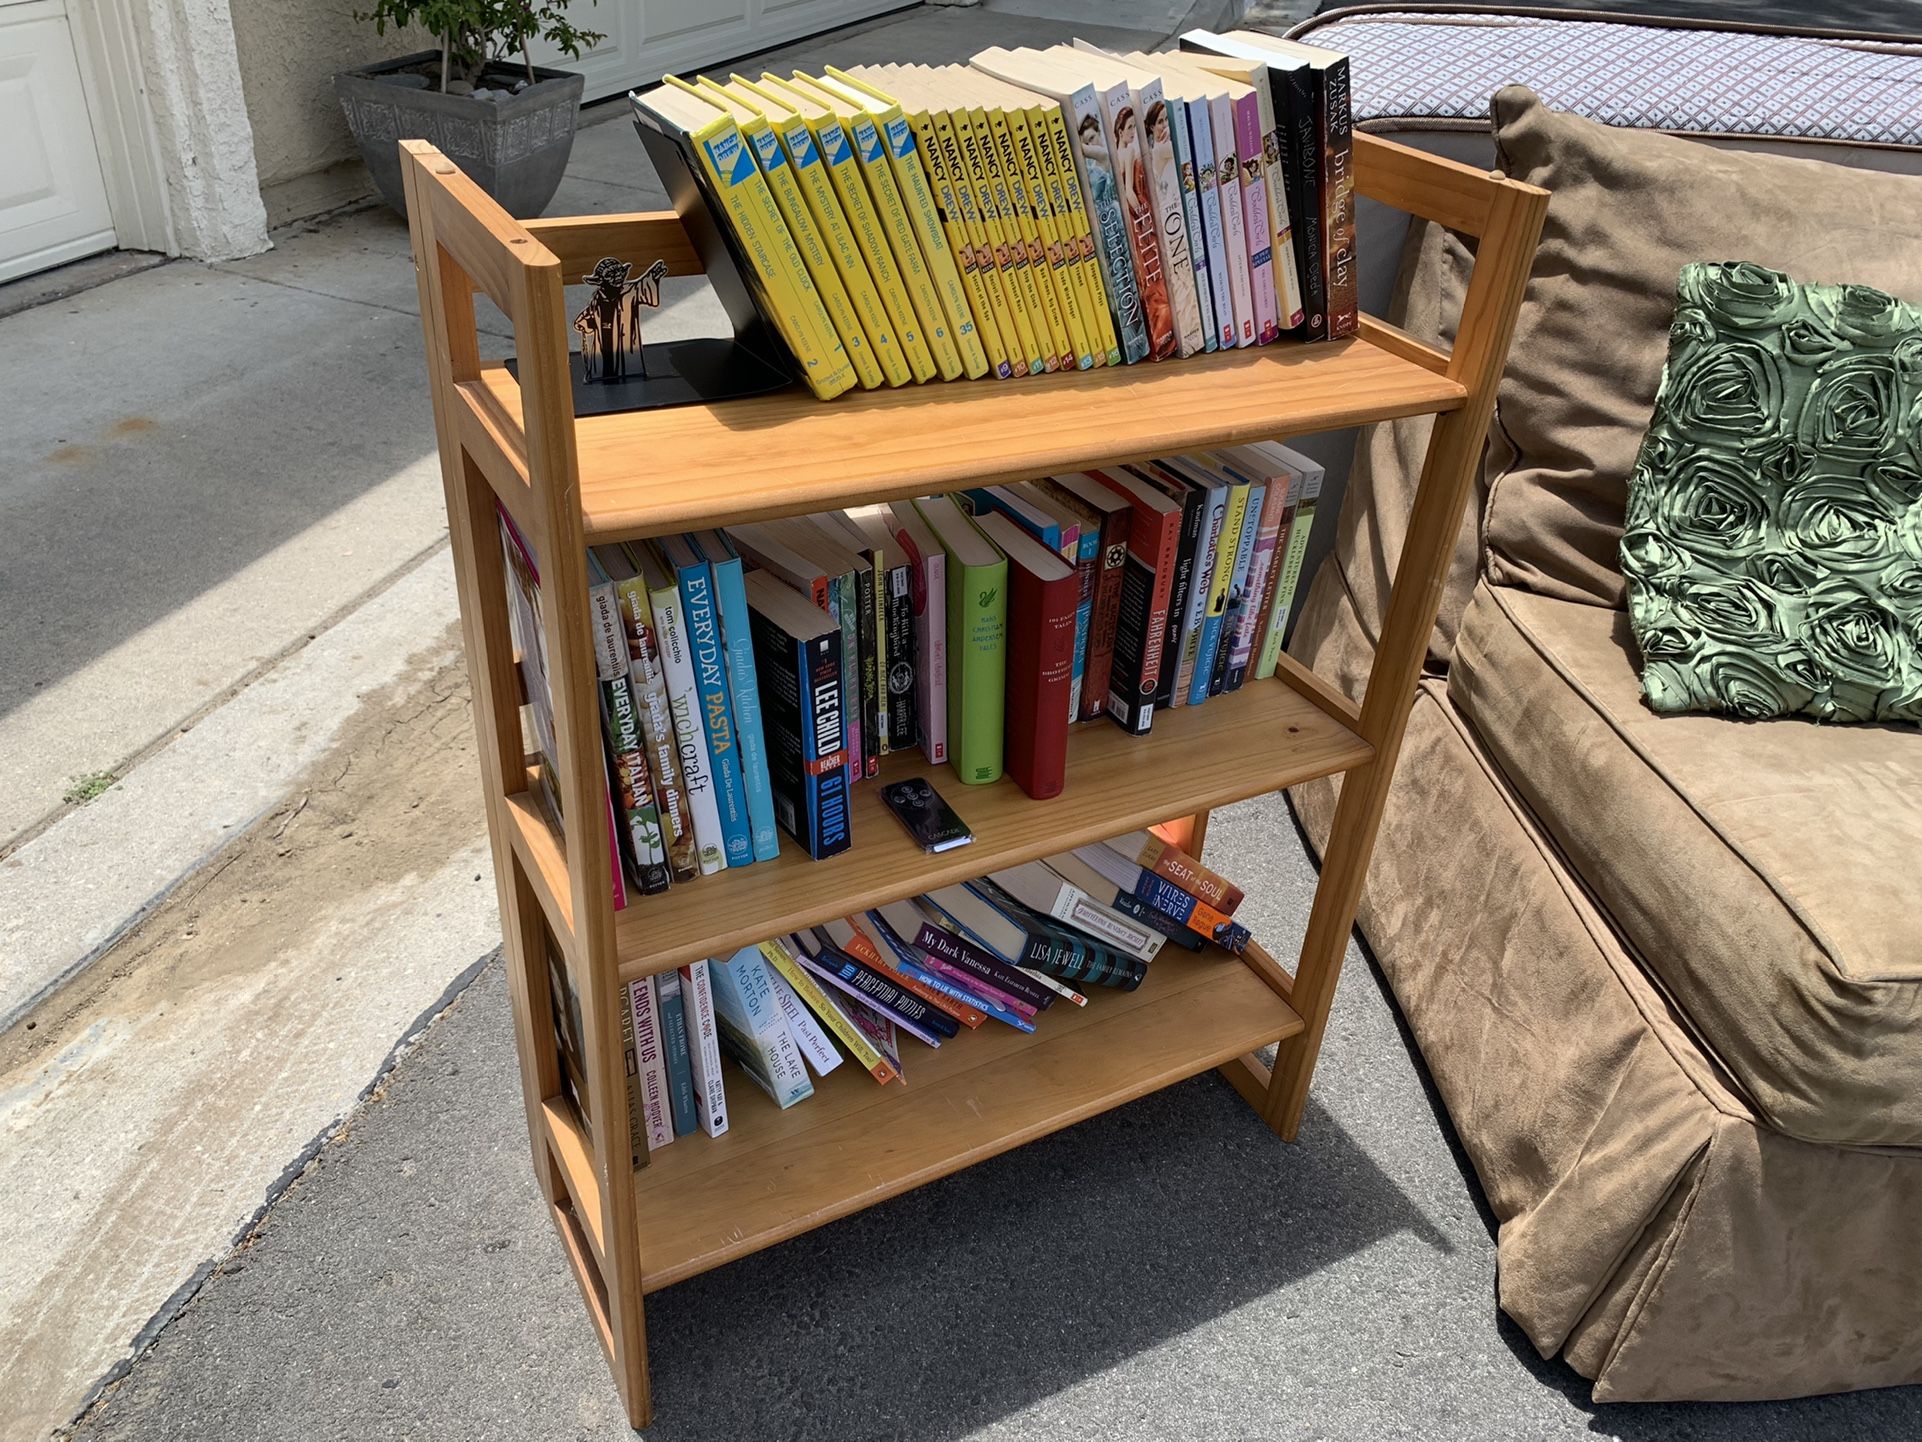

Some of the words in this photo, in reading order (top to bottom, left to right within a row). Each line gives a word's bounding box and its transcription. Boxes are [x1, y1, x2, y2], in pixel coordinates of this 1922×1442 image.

[1074, 94, 1094, 109] CASS
[1110, 92, 1130, 106] CASS
[1143, 90, 1162, 104] CASS
[1329, 78, 1338, 133] ZUSAK
[1337, 66, 1348, 136] MARKUS
[1054, 130, 1073, 174] NANCY
[1066, 176, 1082, 211] DREW
[1298, 116, 1316, 188] JAWBONE
[924, 136, 947, 182] NANCY
[940, 185, 958, 221] DREW
[942, 136, 964, 182] NANCY
[958, 185, 976, 220] DREW
[964, 136, 984, 182] NANCY
[979, 184, 996, 220] DREW
[980, 134, 1000, 180] NANCY
[995, 182, 1012, 218] DREW
[998, 132, 1018, 178] NANCY
[1012, 180, 1028, 215] DREW
[1019, 136, 1039, 182] NANCY
[1032, 184, 1049, 218] DREW
[1038, 132, 1056, 178] NANCY
[1050, 180, 1066, 214] DREW
[1334, 149, 1350, 222] bridge
[816, 186, 836, 221] MYSTERY
[1165, 202, 1178, 214] THE
[738, 211, 756, 239] HIDDEN
[753, 241, 776, 279] STAIRCASE
[804, 232, 824, 266] MYSTERY
[1134, 212, 1164, 287] ELITE
[1164, 211, 1190, 276] ONE
[1333, 228, 1350, 244] of
[1100, 208, 1138, 328] SELECTION
[1333, 248, 1352, 287] clay
[852, 336, 861, 347] 3
[880, 334, 888, 344] 4
[906, 331, 914, 342] 5
[936, 328, 944, 338] 6
[960, 320, 974, 336] 35
[807, 359, 818, 368] 2
[1234, 497, 1246, 534] STAND
[1238, 498, 1260, 574] UNSTOPPABLE
[1181, 558, 1192, 579] light
[1221, 536, 1238, 582] STRONG
[1178, 580, 1188, 604] filters
[1198, 563, 1215, 594] Web
[596, 596, 610, 620] giada
[604, 620, 612, 632] de
[627, 590, 640, 620] giada
[635, 622, 645, 636] de
[665, 606, 674, 624] tom
[900, 618, 908, 635] Kill
[1174, 606, 1182, 618] in
[669, 625, 682, 664] colicchio
[890, 598, 901, 657] Mockingbird
[1145, 610, 1166, 676] FAHRENHEIT
[1188, 626, 1199, 656] WHITE
[1208, 618, 1219, 640] NICK
[606, 632, 621, 678] laurentiis
[688, 577, 722, 686] EVERYDAY
[706, 692, 732, 755] PASTA
[814, 680, 838, 714] LEE
[643, 692, 666, 742] giada's
[816, 710, 841, 756] CHILD
[612, 678, 638, 754] EVERYDAY
[626, 750, 650, 807] ITALIAN
[658, 744, 676, 785] family
[722, 759, 730, 778] Giada
[821, 776, 841, 795] 61
[666, 788, 683, 837] dinners
[822, 792, 845, 846] HOURS
[1159, 880, 1191, 909] WIRES
[1168, 861, 1193, 881] SEAT
[1200, 880, 1224, 901] SOUL
[1155, 896, 1185, 920] NERVE
[922, 931, 937, 945] My
[936, 938, 959, 959] Dark
[960, 951, 991, 974] Vanessa
[1031, 942, 1051, 962] LISA
[1052, 947, 1084, 970] JEWELL
[696, 980, 709, 1020] CONFIDENCE
[736, 966, 762, 1017] MORTON
[751, 965, 770, 998] KATE
[851, 970, 898, 1006] PERCEPTUAL
[894, 995, 926, 1020] PUZZLES
[918, 974, 932, 986] HOW
[932, 981, 940, 989] TO
[939, 983, 949, 994] LIE
[949, 988, 963, 1000] WITH
[962, 994, 989, 1012] STATISTICS
[633, 987, 649, 1016] ENDS
[778, 994, 800, 1022] STEEL
[638, 1014, 654, 1047] WITH
[701, 1020, 713, 1039] CODE
[818, 1002, 827, 1011] So
[825, 1008, 838, 1022] Your
[835, 1019, 856, 1042] Children
[642, 1046, 656, 1063] US
[777, 1031, 792, 1051] THE
[786, 1052, 800, 1079] LAKE
[798, 1020, 812, 1038] Past
[808, 1036, 830, 1064] Perfect
[768, 1047, 786, 1080] HOUSE
[646, 1070, 659, 1097] COLLEEN
[630, 1114, 642, 1149] GRACE
[650, 1098, 662, 1128] HOOVER
